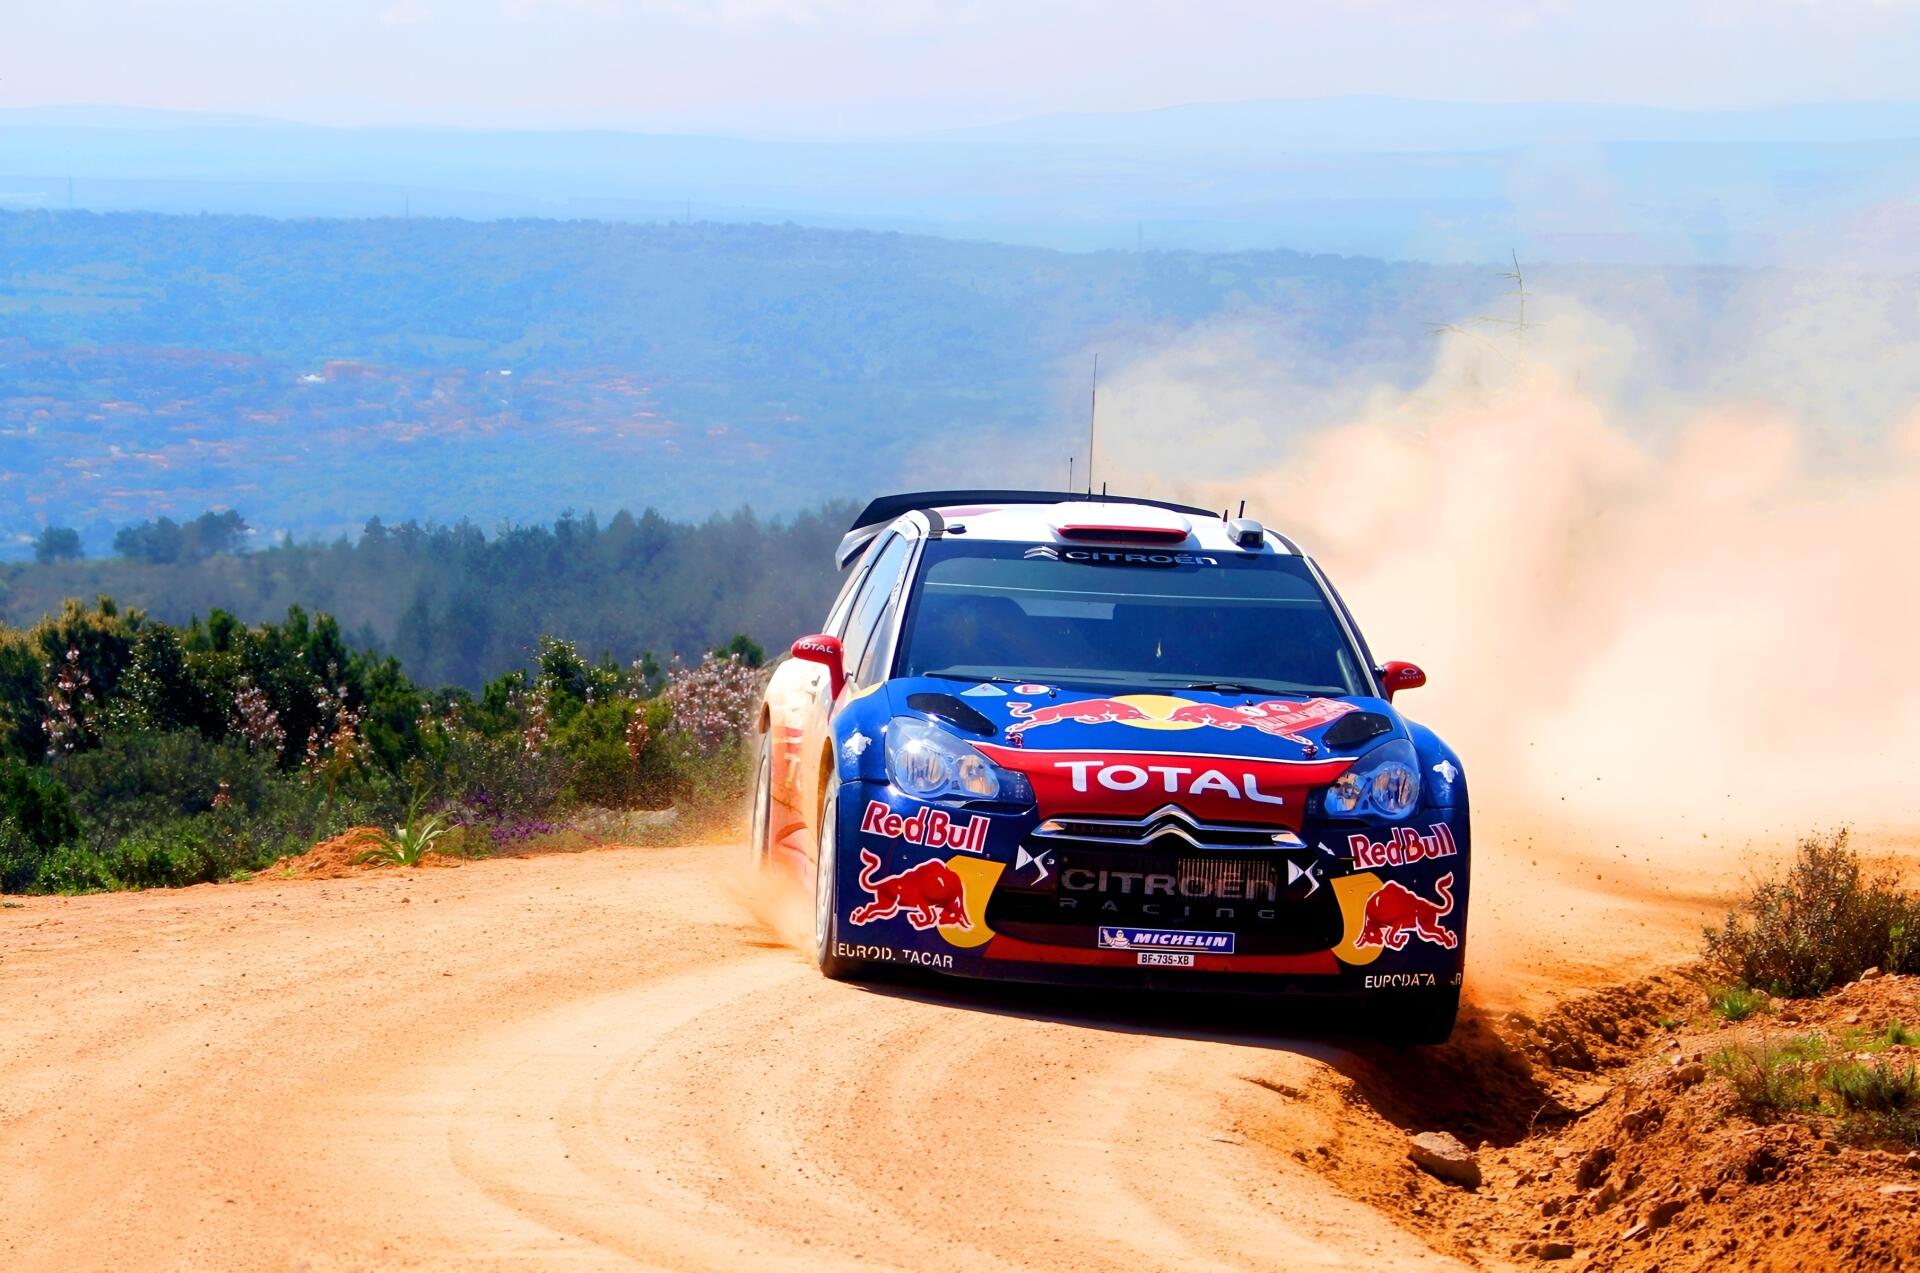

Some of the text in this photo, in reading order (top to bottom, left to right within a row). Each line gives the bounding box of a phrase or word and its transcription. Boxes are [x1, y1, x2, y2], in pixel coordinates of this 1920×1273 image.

[797, 641, 834, 654] TOTAL
[1053, 760, 1283, 805] TOTAL
[1132, 932, 1228, 947] MICHELIN
[1141, 953, 1190, 965] BF-735-XB
